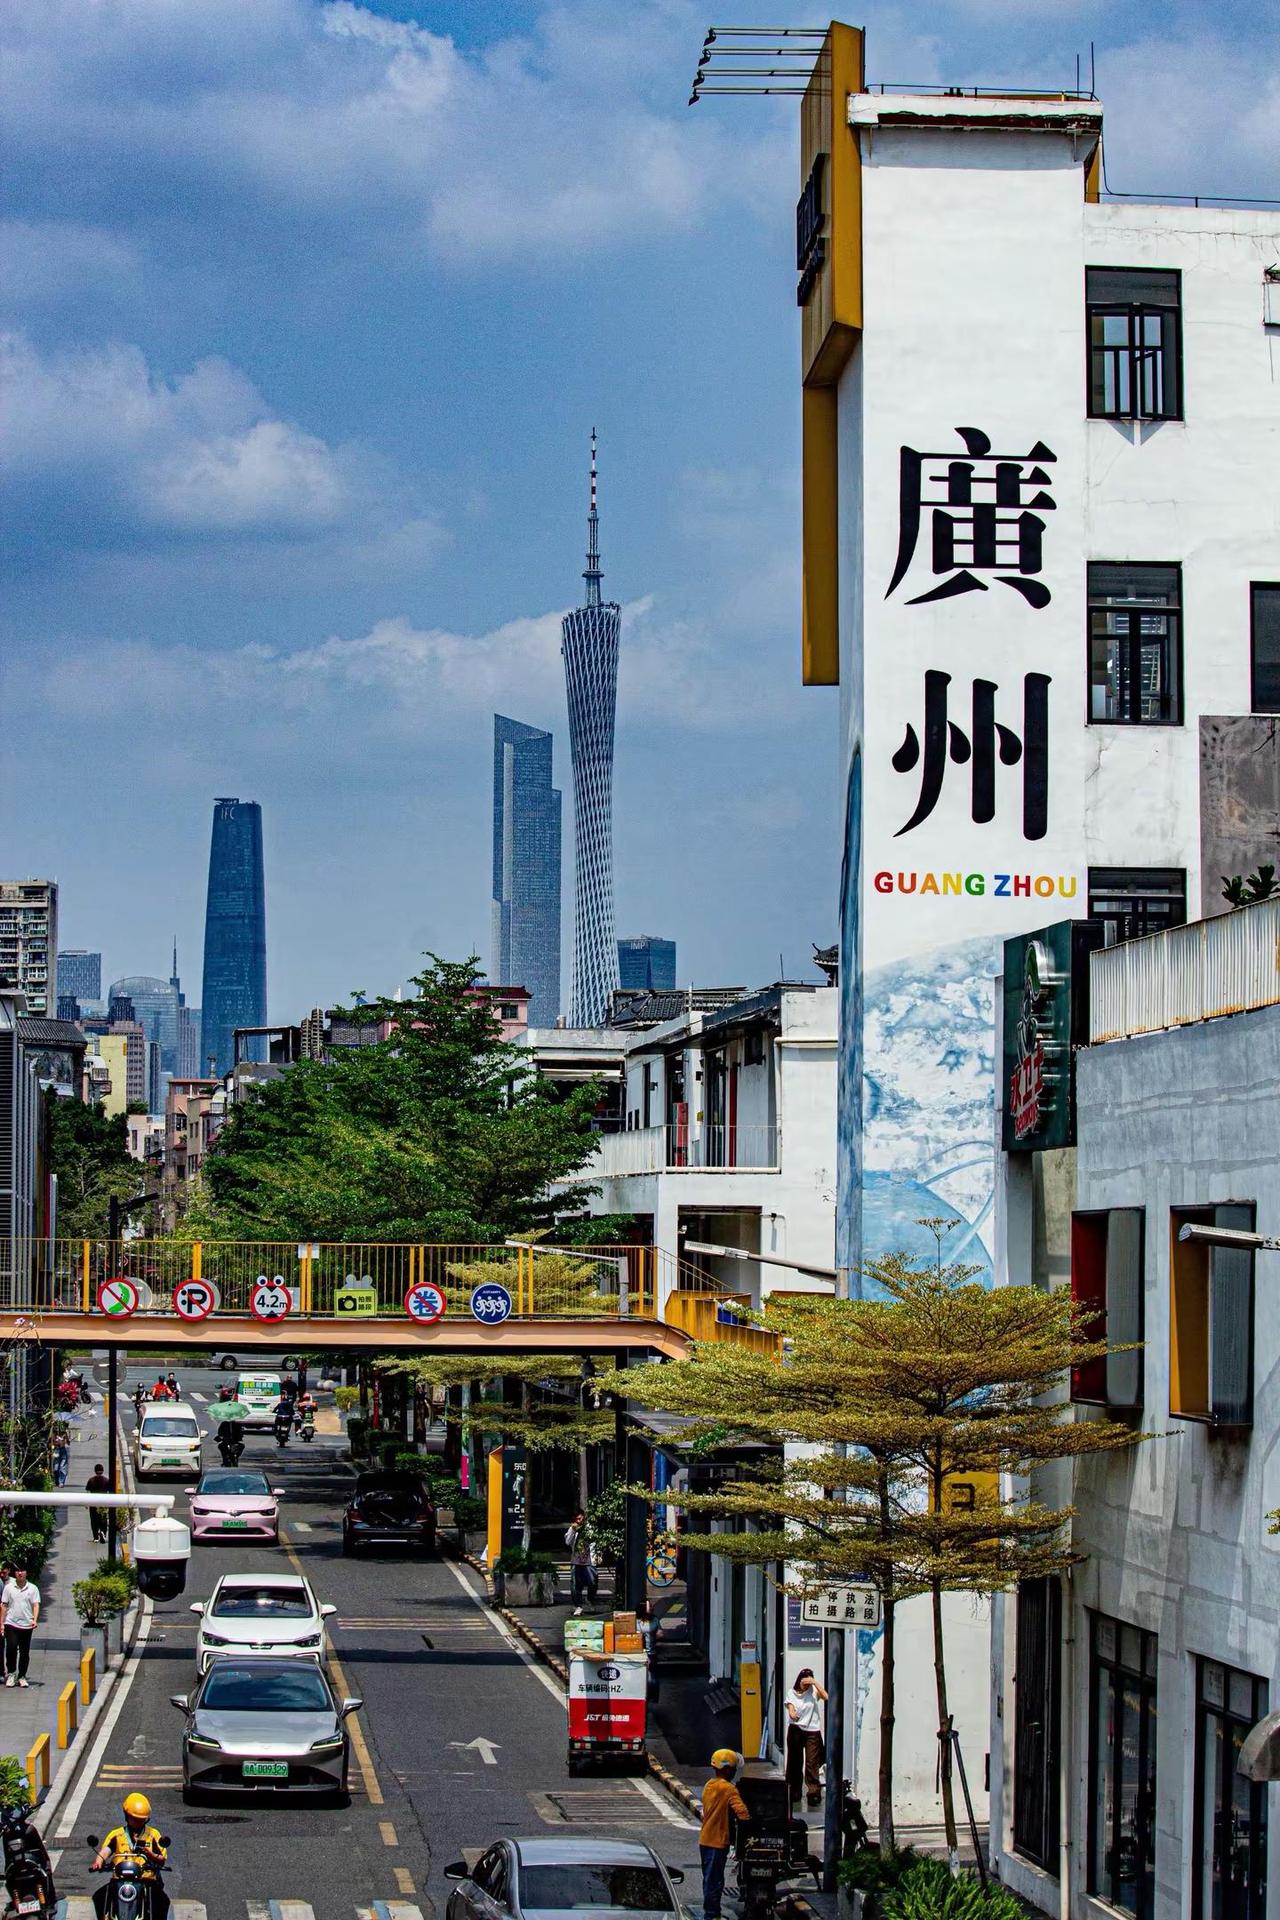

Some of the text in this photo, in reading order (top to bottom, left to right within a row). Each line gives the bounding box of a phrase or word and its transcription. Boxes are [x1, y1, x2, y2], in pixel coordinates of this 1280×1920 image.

[884, 427, 1058, 842] 廣州
[874, 872, 1077, 898] GUANG ZHOU
[256, 1294, 288, 1309] 4.2m
[809, 1590, 875, 1605] 停执法
[808, 1604, 874, 1620] 拍摄路段
[583, 1713, 601, 1722] J&T
